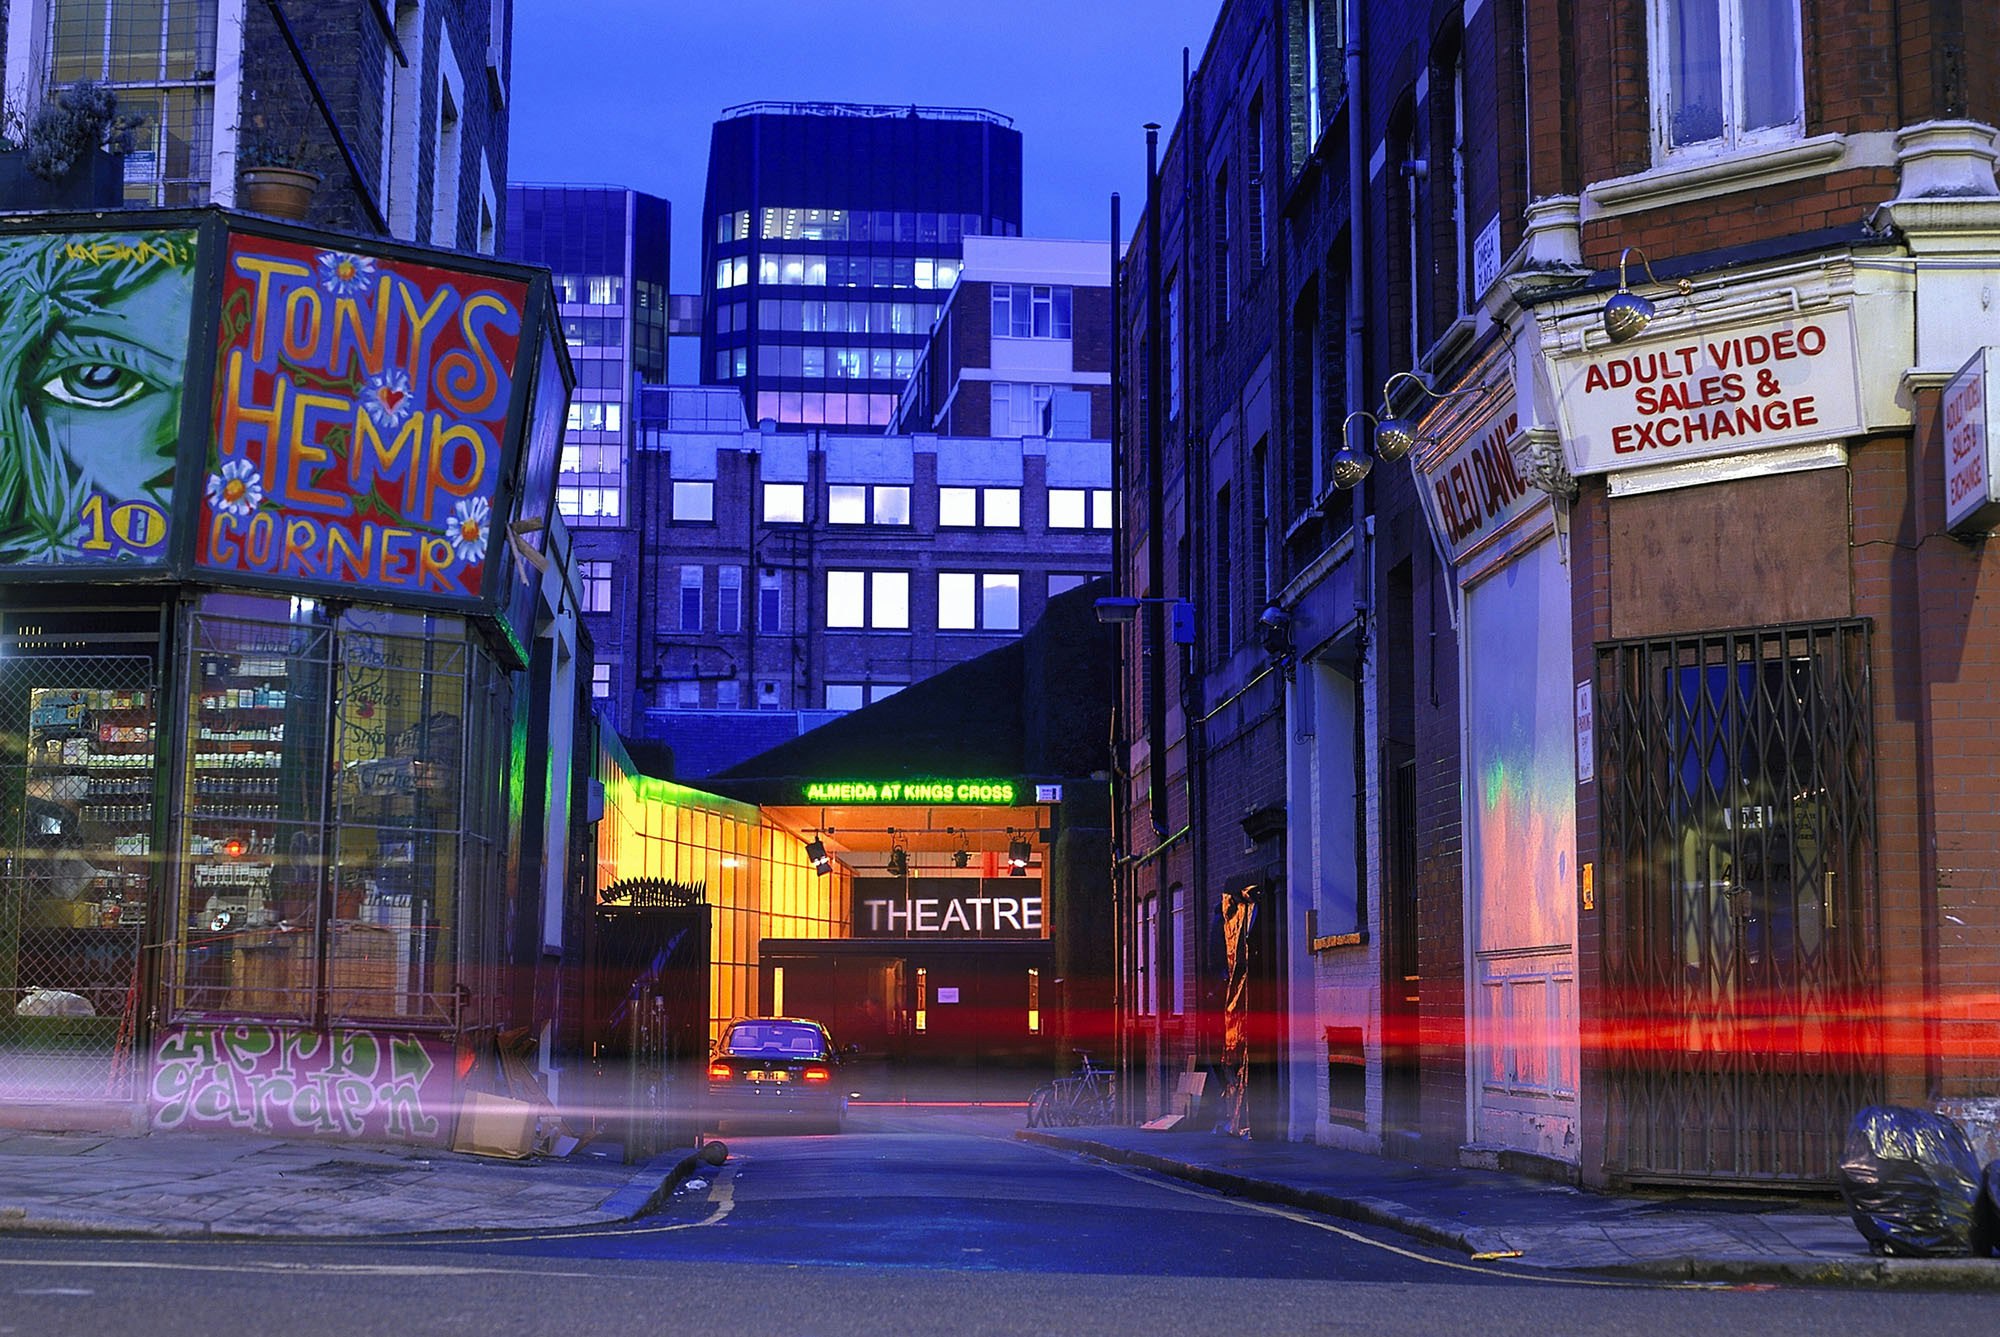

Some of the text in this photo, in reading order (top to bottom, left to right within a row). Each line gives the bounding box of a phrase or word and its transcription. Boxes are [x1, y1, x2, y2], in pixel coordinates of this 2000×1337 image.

[235, 256, 508, 414] TONYS
[1585, 325, 1826, 394] ADULT VIDEO
[1635, 368, 1782, 416] SALES &
[222, 350, 486, 521] HEMP
[1611, 396, 1819, 455] EXCHANGE
[80, 491, 167, 552] 10
[211, 512, 456, 591] CORNER
[807, 784, 1014, 802] ALMEIDA AT KINGS CROSS
[864, 897, 1042, 932] THEATRE
[152, 1061, 439, 1138] garden
